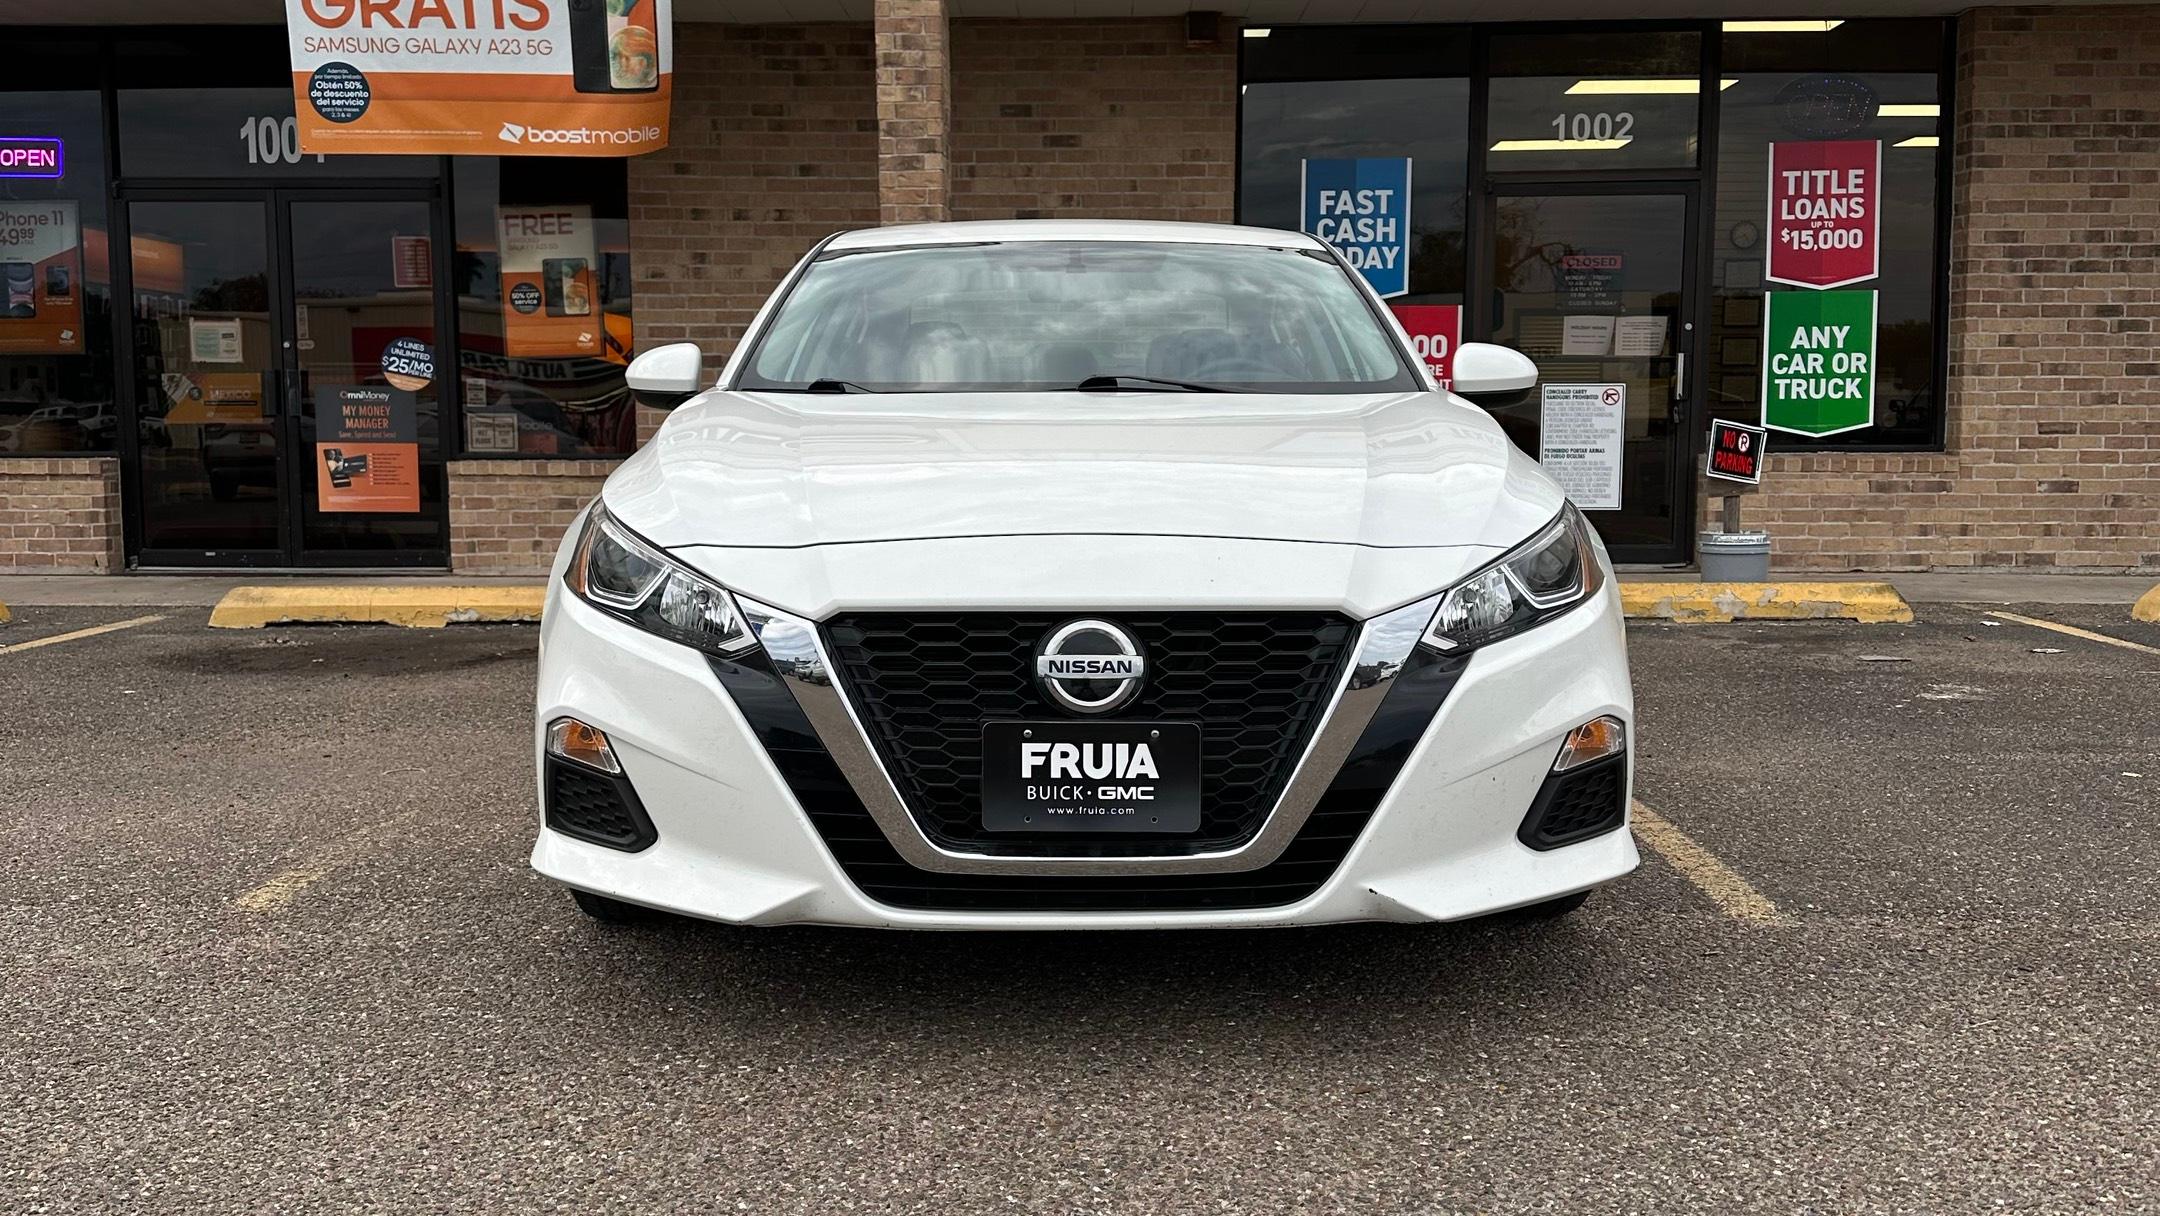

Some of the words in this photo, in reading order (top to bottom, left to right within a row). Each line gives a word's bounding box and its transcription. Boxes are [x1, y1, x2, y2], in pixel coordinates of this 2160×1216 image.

[304, 36, 400, 53] SAMSUNG
[405, 38, 481, 54] GALAXY
[487, 39, 520, 55] A23
[527, 39, 552, 55] 5G
[315, 81, 343, 89] Obtén
[344, 81, 363, 89] 50%
[323, 90, 369, 98] descuento
[316, 98, 330, 106] del
[331, 98, 365, 106] servicio
[1552, 112, 1634, 141] 1002
[240, 116, 325, 164] 100
[0, 149, 55, 167] OPEN
[1782, 169, 1865, 196] TITLE
[1319, 190, 1394, 215] FAST
[1781, 197, 1865, 220] LOANS
[51, 210, 64, 226] 11
[503, 213, 574, 236] FREE
[1823, 220, 1834, 228] TO
[1317, 218, 1397, 243] CASH
[1781, 227, 1863, 252] $15,000
[1337, 246, 1400, 269] DAY
[1566, 257, 1617, 268] CLOSED
[397, 340, 403, 348] 4
[403, 341, 425, 352] LINES
[1413, 334, 1448, 359] 00
[1790, 325, 1850, 349] ANY
[390, 347, 430, 361] UNLIMITED
[1772, 353, 1824, 375] CAR
[1831, 352, 1867, 374] OR
[381, 355, 434, 374] $25/MO
[1427, 364, 1444, 376] RE
[340, 391, 390, 401] OmniMoney
[1774, 378, 1863, 399] TRUCK
[342, 405, 357, 416] MY
[359, 405, 391, 416] MONEY
[345, 418, 389, 429] MANAGER
[1722, 429, 1736, 449] NO
[1715, 450, 1753, 475] PARKING
[1048, 660, 1133, 674] NISSAN
[1021, 742, 1160, 780] FRUIA
[1027, 785, 1084, 800] BUICK
[1097, 786, 1155, 800] GMC
[1047, 806, 1135, 815] www.fruia.com
